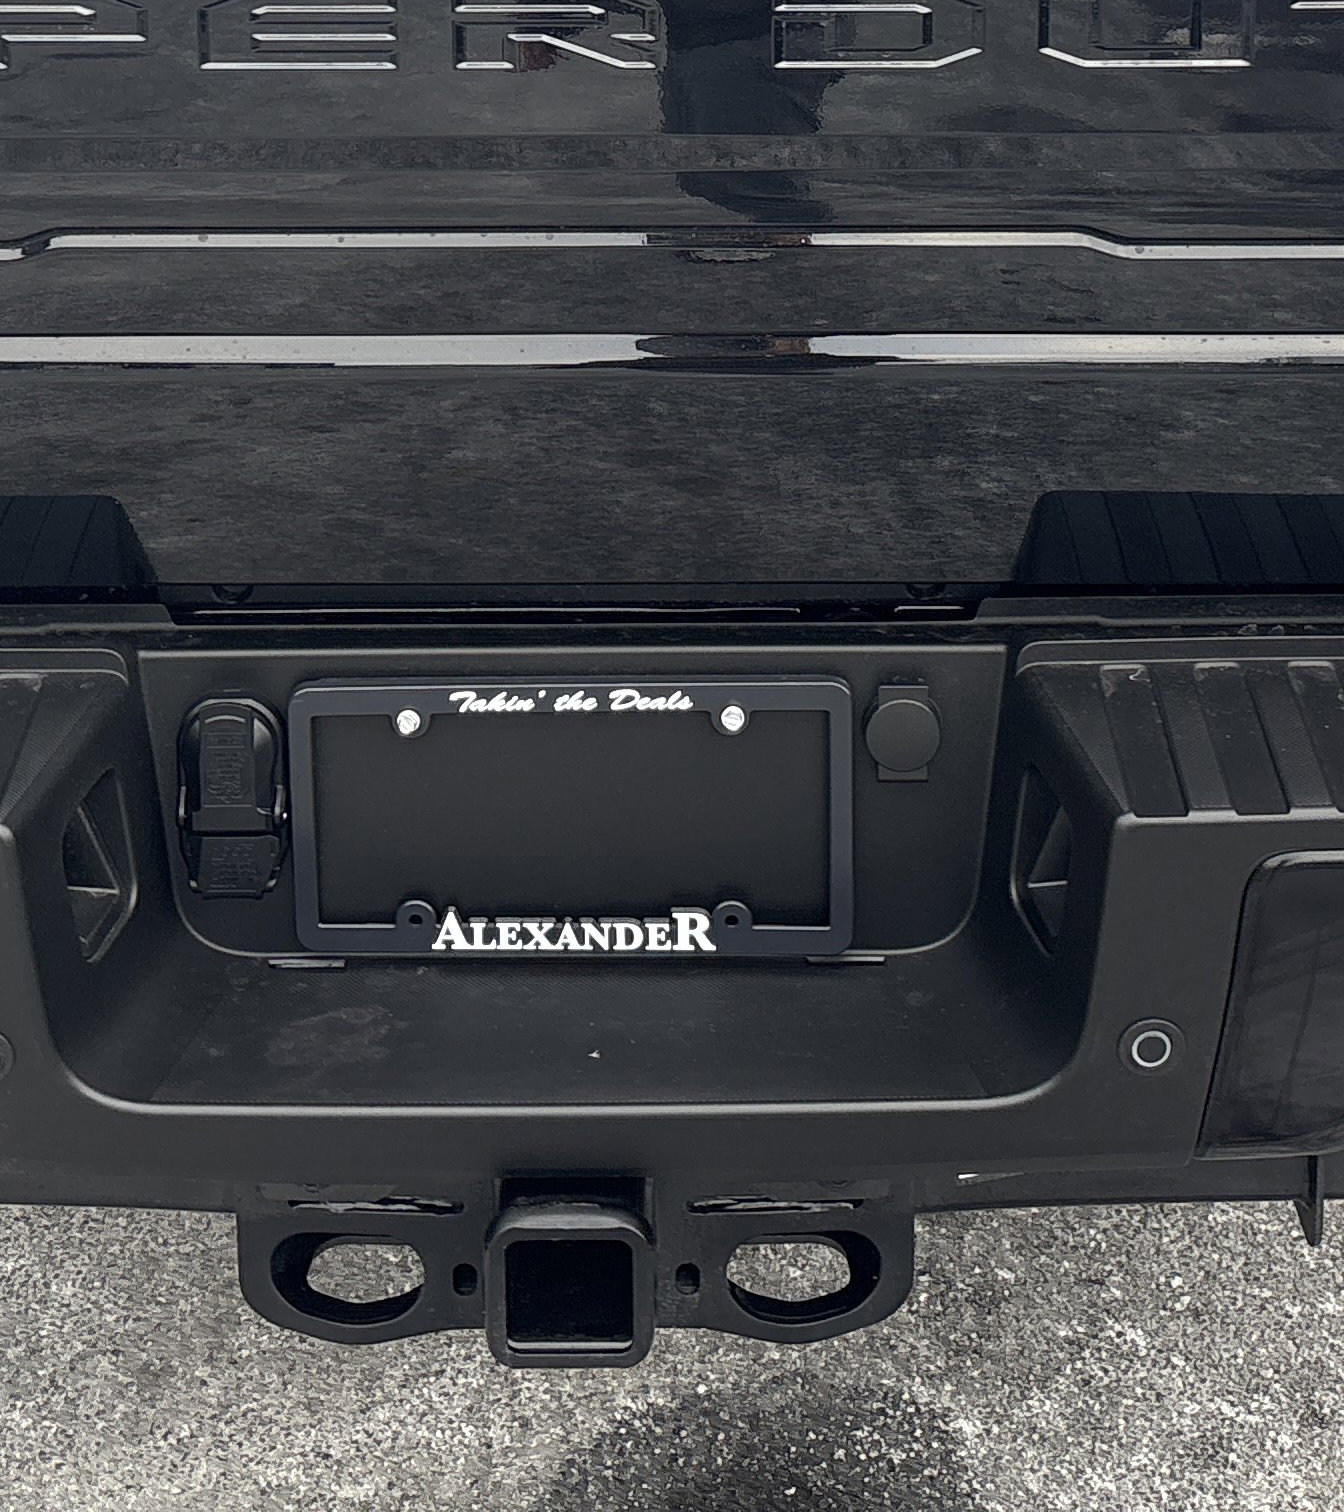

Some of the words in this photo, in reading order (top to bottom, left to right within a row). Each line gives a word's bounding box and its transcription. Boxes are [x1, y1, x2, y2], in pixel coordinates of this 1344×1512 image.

[448, 689, 547, 713] Takin'
[553, 690, 598, 712] the
[608, 688, 694, 712] Deals
[431, 909, 717, 952] ALEXANDER
